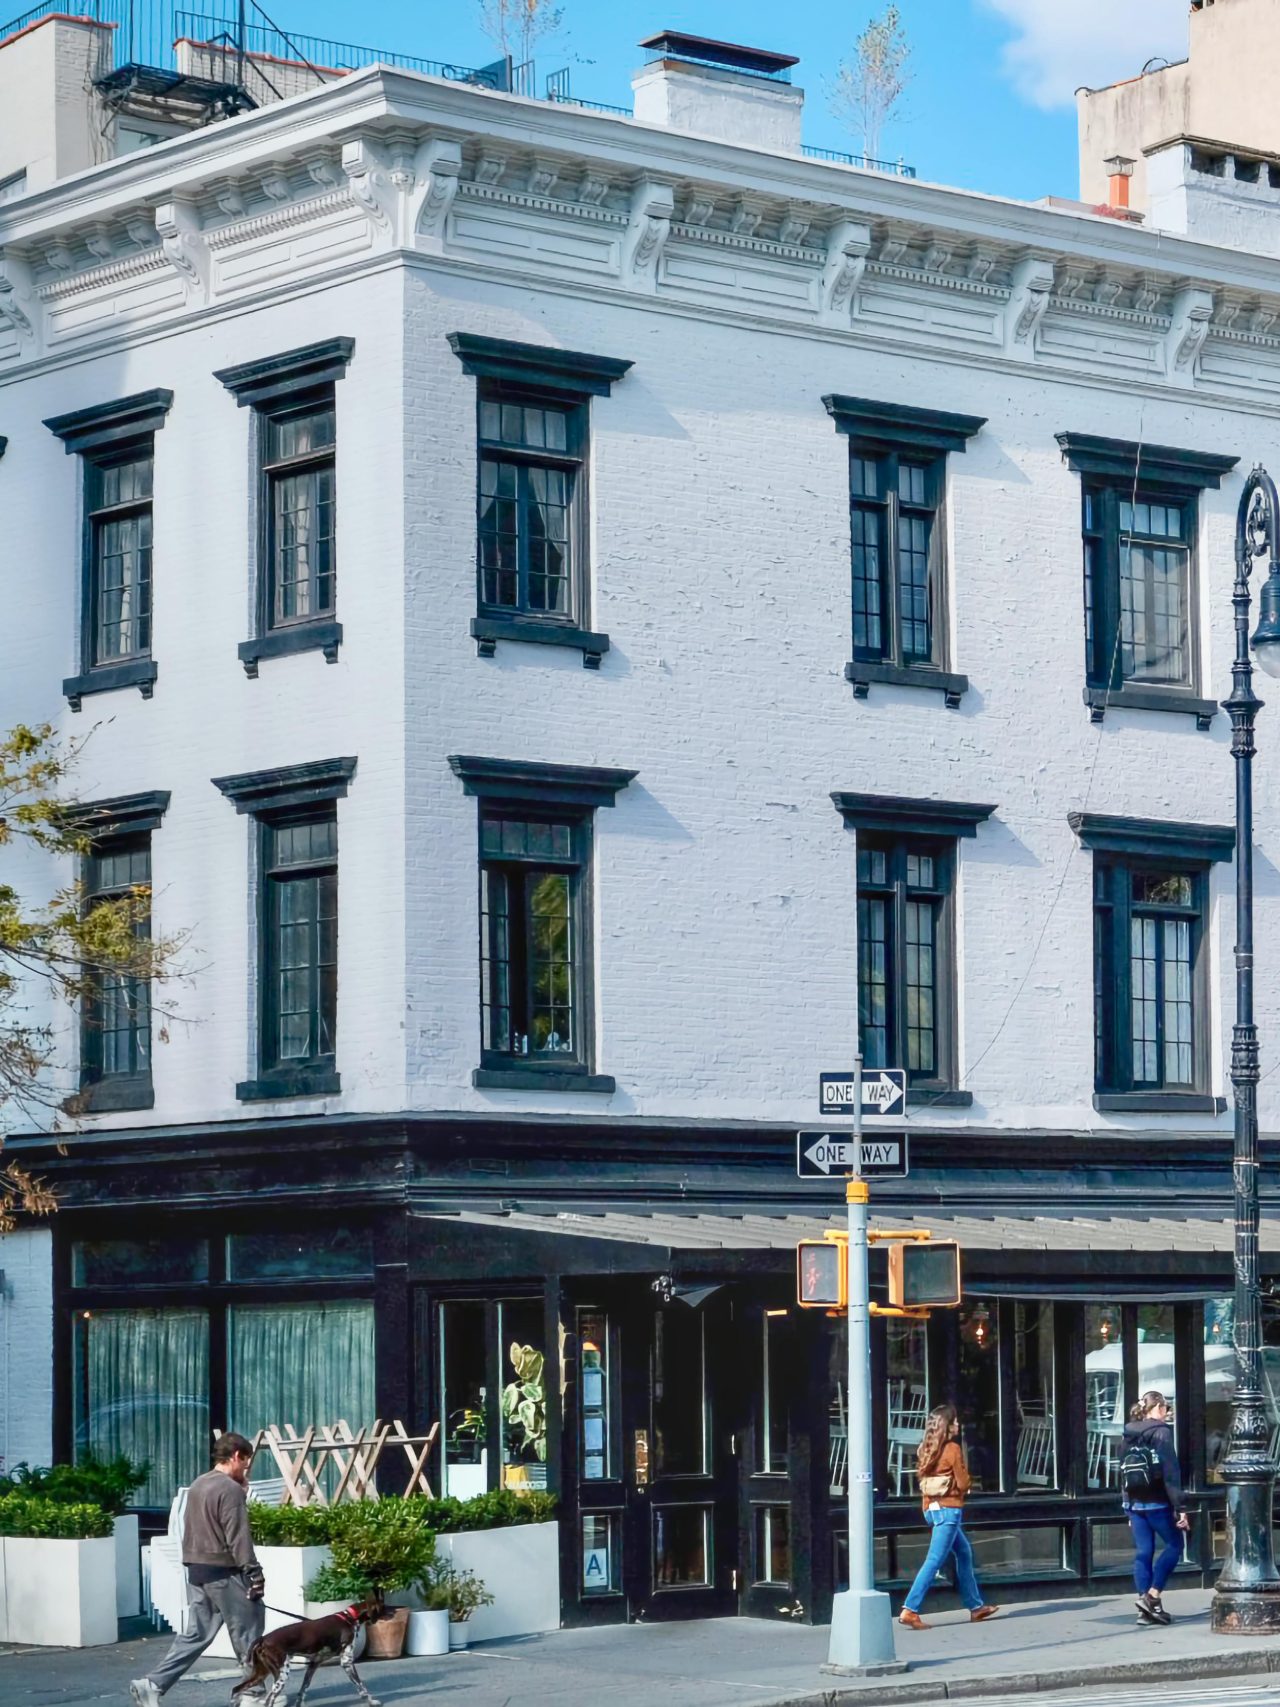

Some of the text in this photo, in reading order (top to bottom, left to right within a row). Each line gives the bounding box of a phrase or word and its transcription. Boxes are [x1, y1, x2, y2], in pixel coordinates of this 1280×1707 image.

[826, 1085, 894, 1102] ONE WAY
[816, 1146, 893, 1162] ONE WAY
[586, 1553, 602, 1576] A
